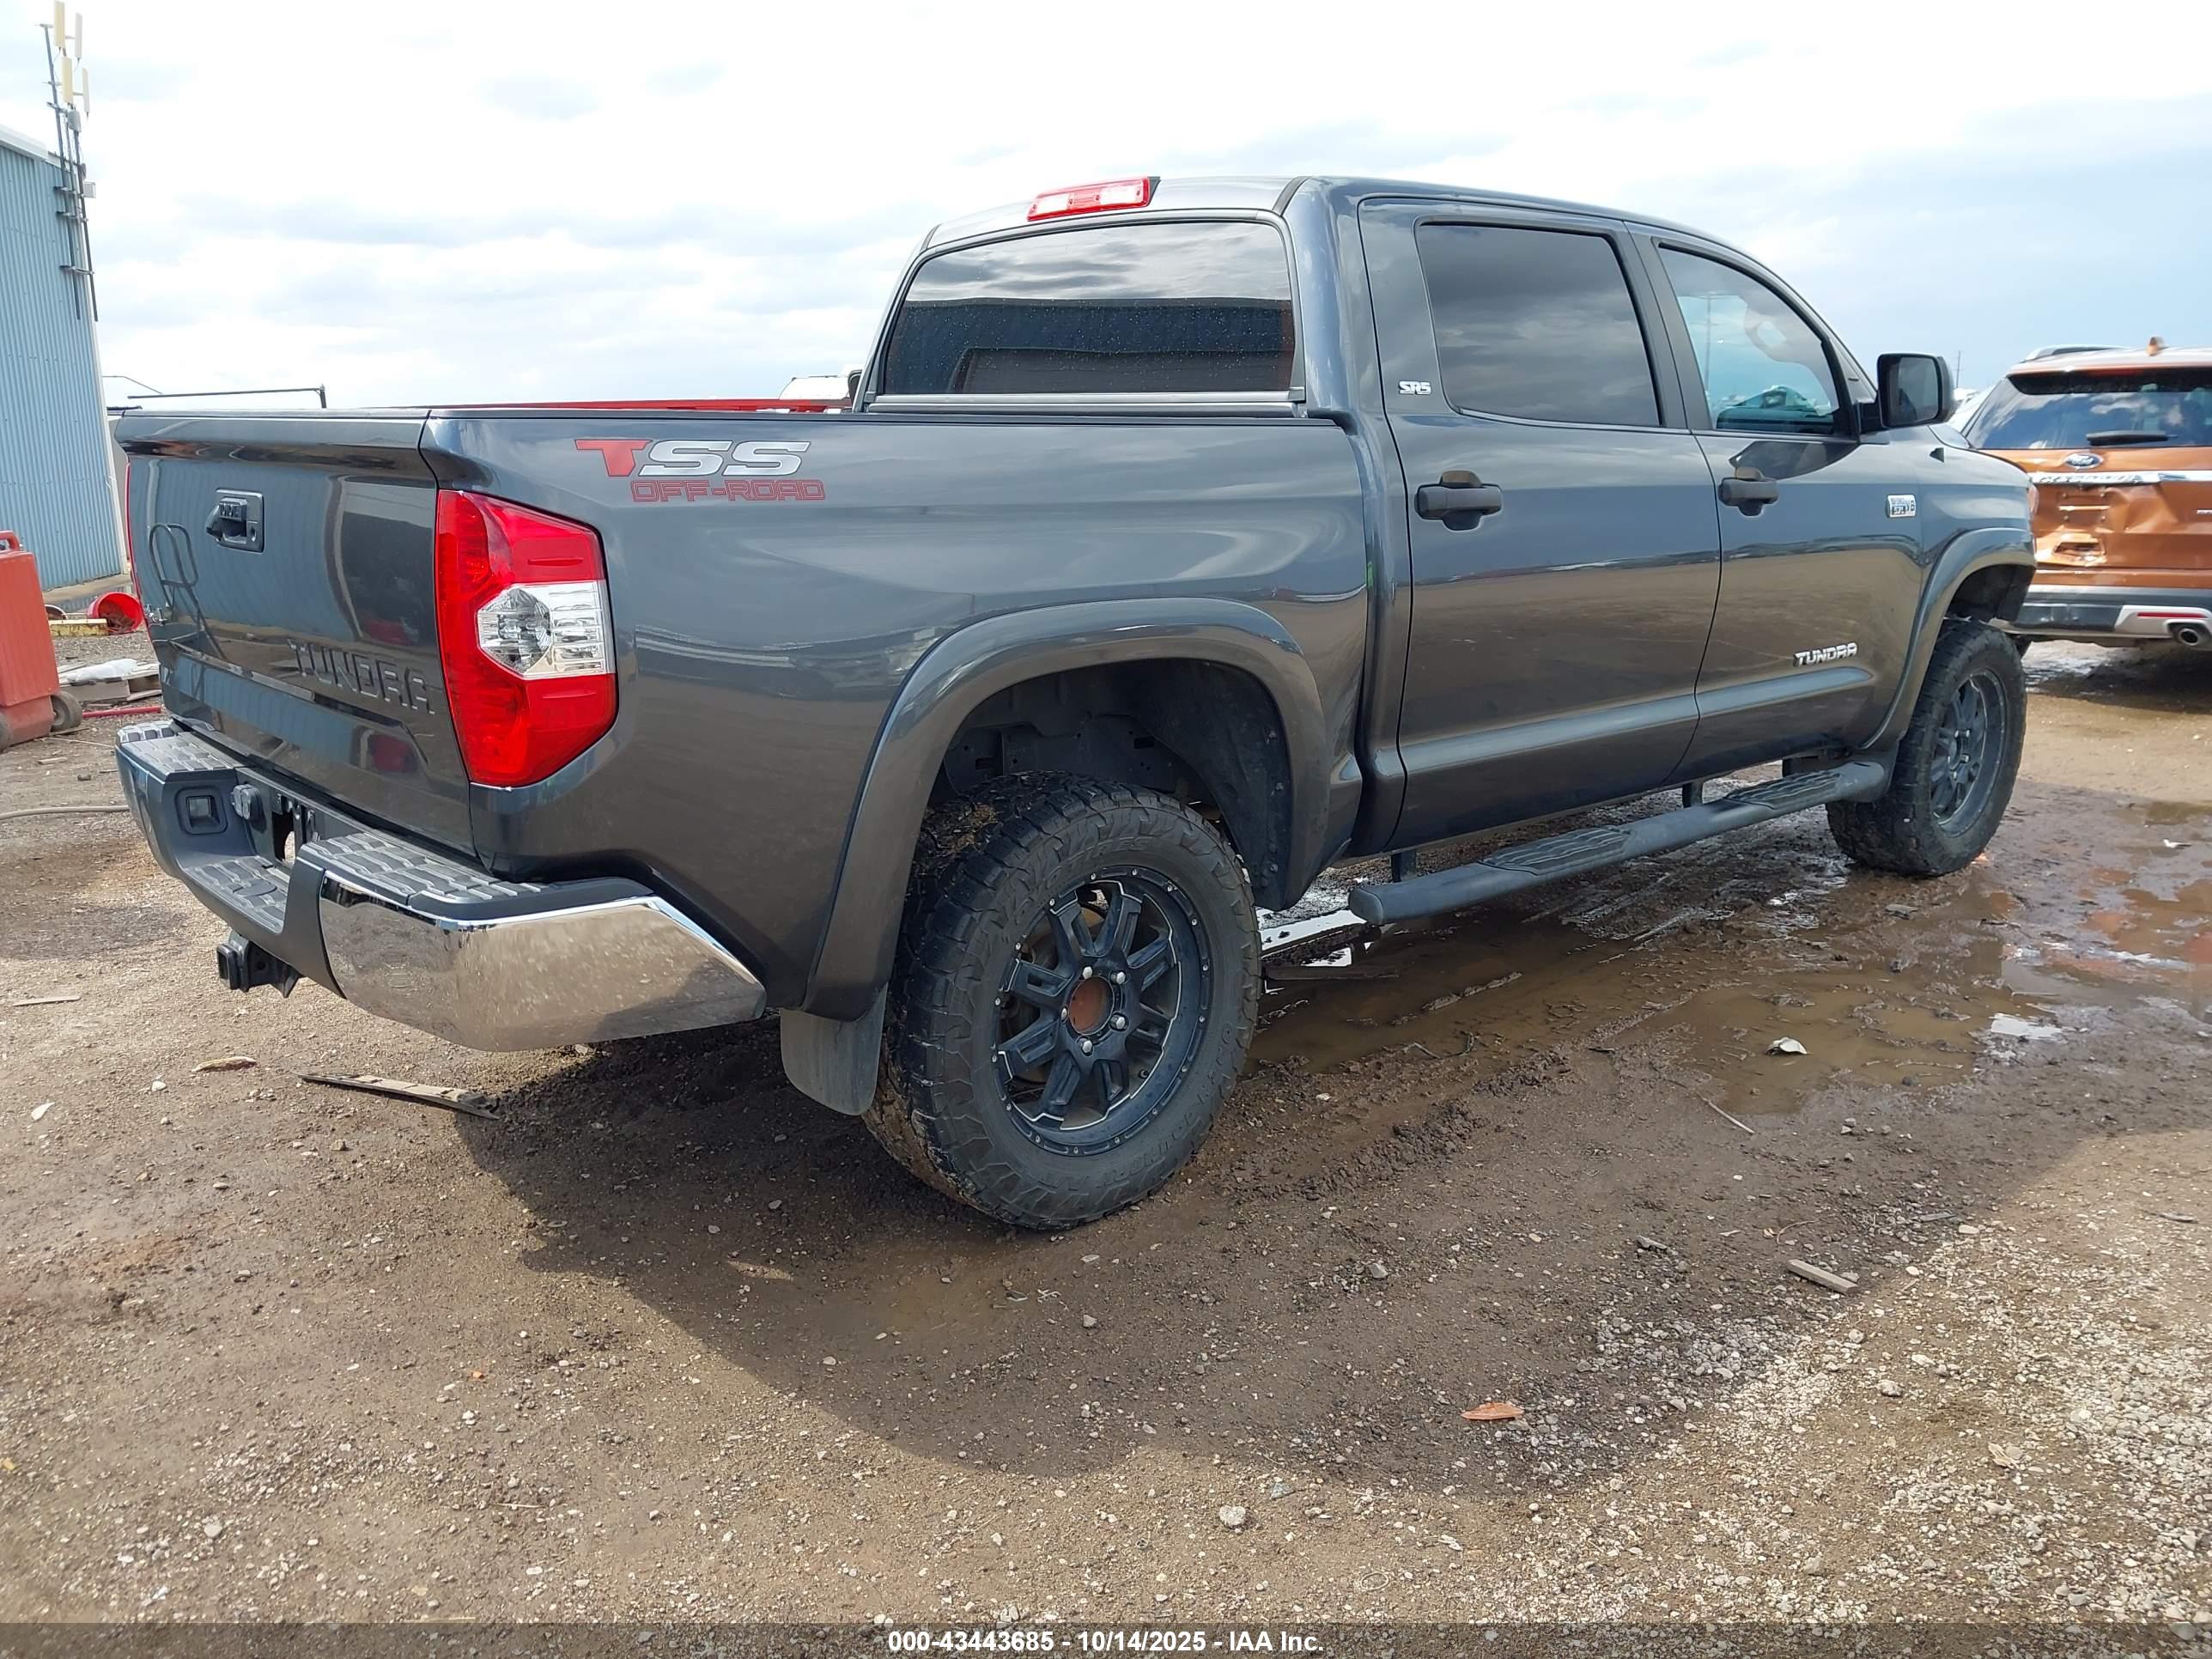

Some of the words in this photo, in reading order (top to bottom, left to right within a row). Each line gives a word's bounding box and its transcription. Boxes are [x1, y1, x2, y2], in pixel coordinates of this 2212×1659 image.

[1399, 381, 1431, 395] SR5
[574, 439, 811, 477] TSS
[630, 479, 826, 502] OFF-ROAD
[1793, 641, 1857, 666] TUNDRA
[287, 639, 436, 714] TUNDRA
